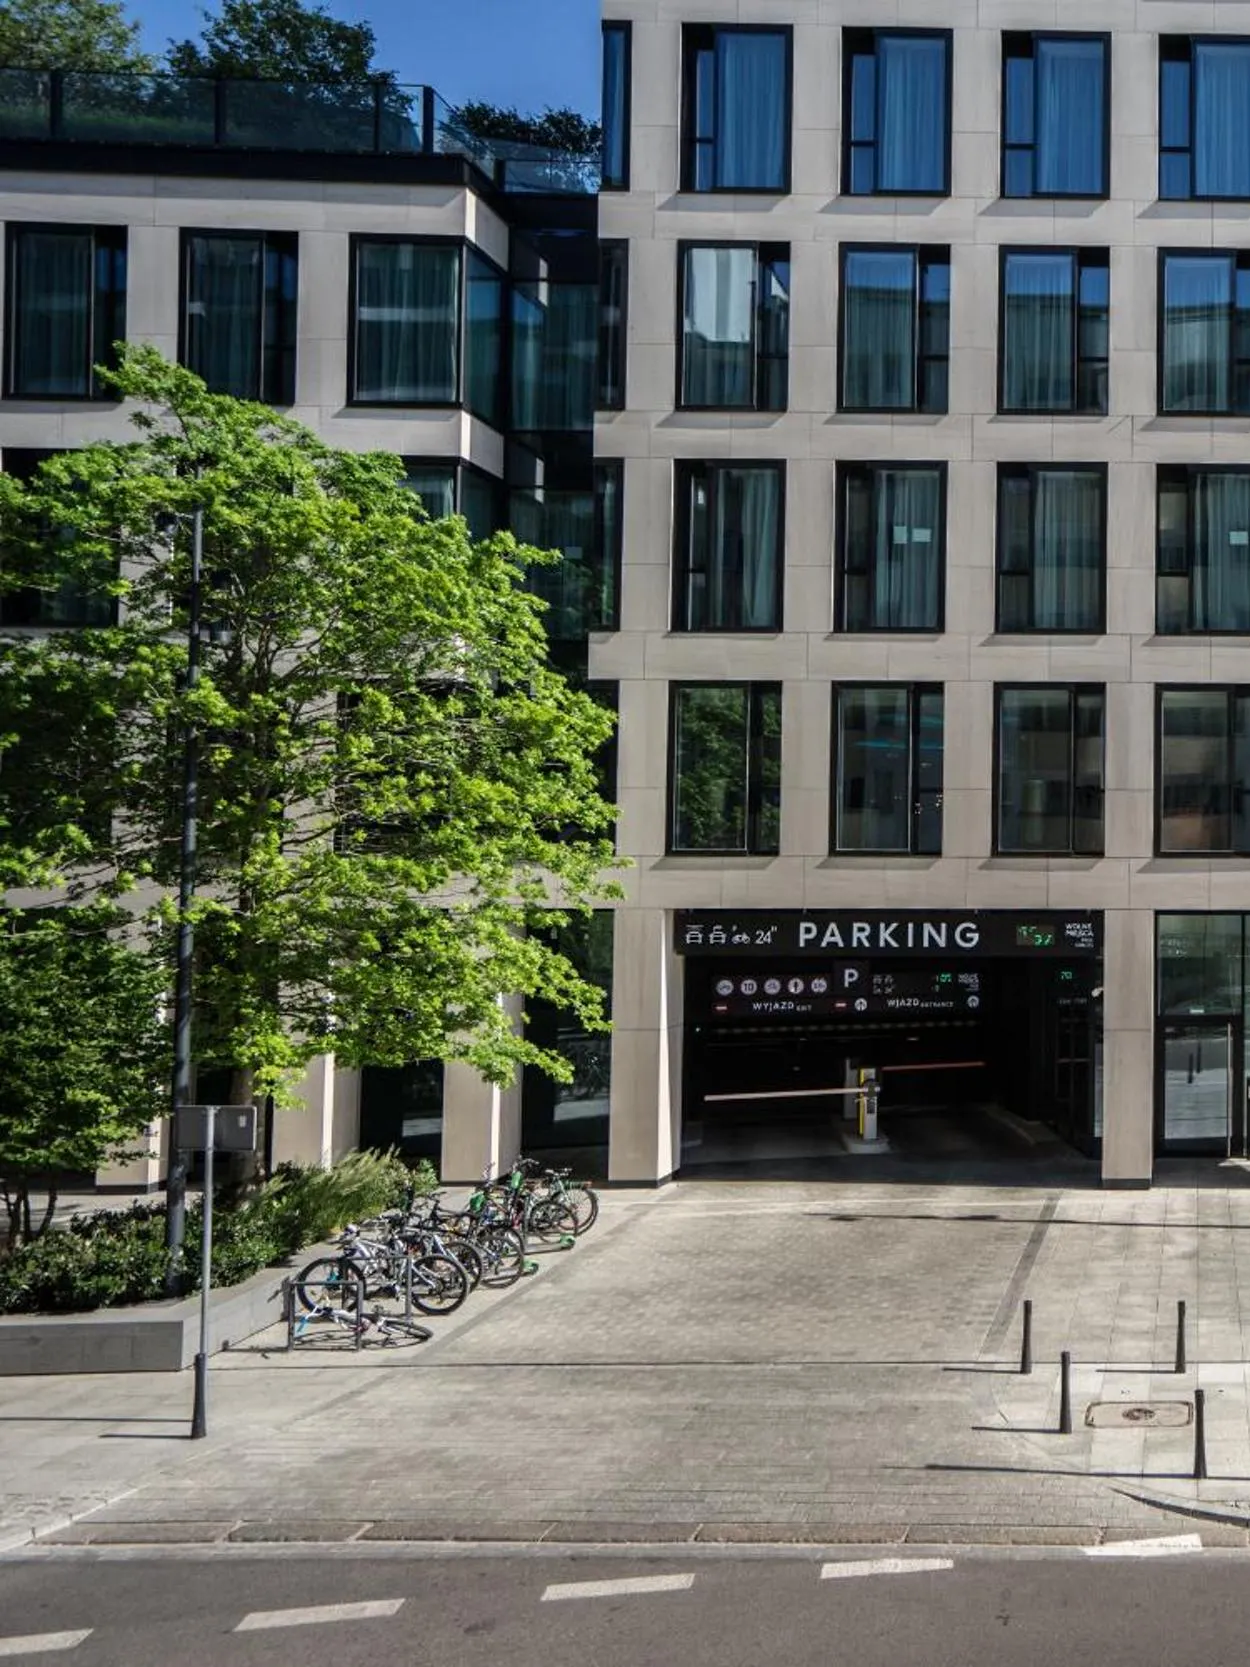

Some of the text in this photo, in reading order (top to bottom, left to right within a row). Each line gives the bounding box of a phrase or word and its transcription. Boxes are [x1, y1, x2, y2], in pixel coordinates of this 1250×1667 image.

[799, 922, 980, 948] PARKING
[844, 968, 859, 988] P
[753, 1001, 795, 1012] WYJAZD
[887, 998, 919, 1008] WJAZD
